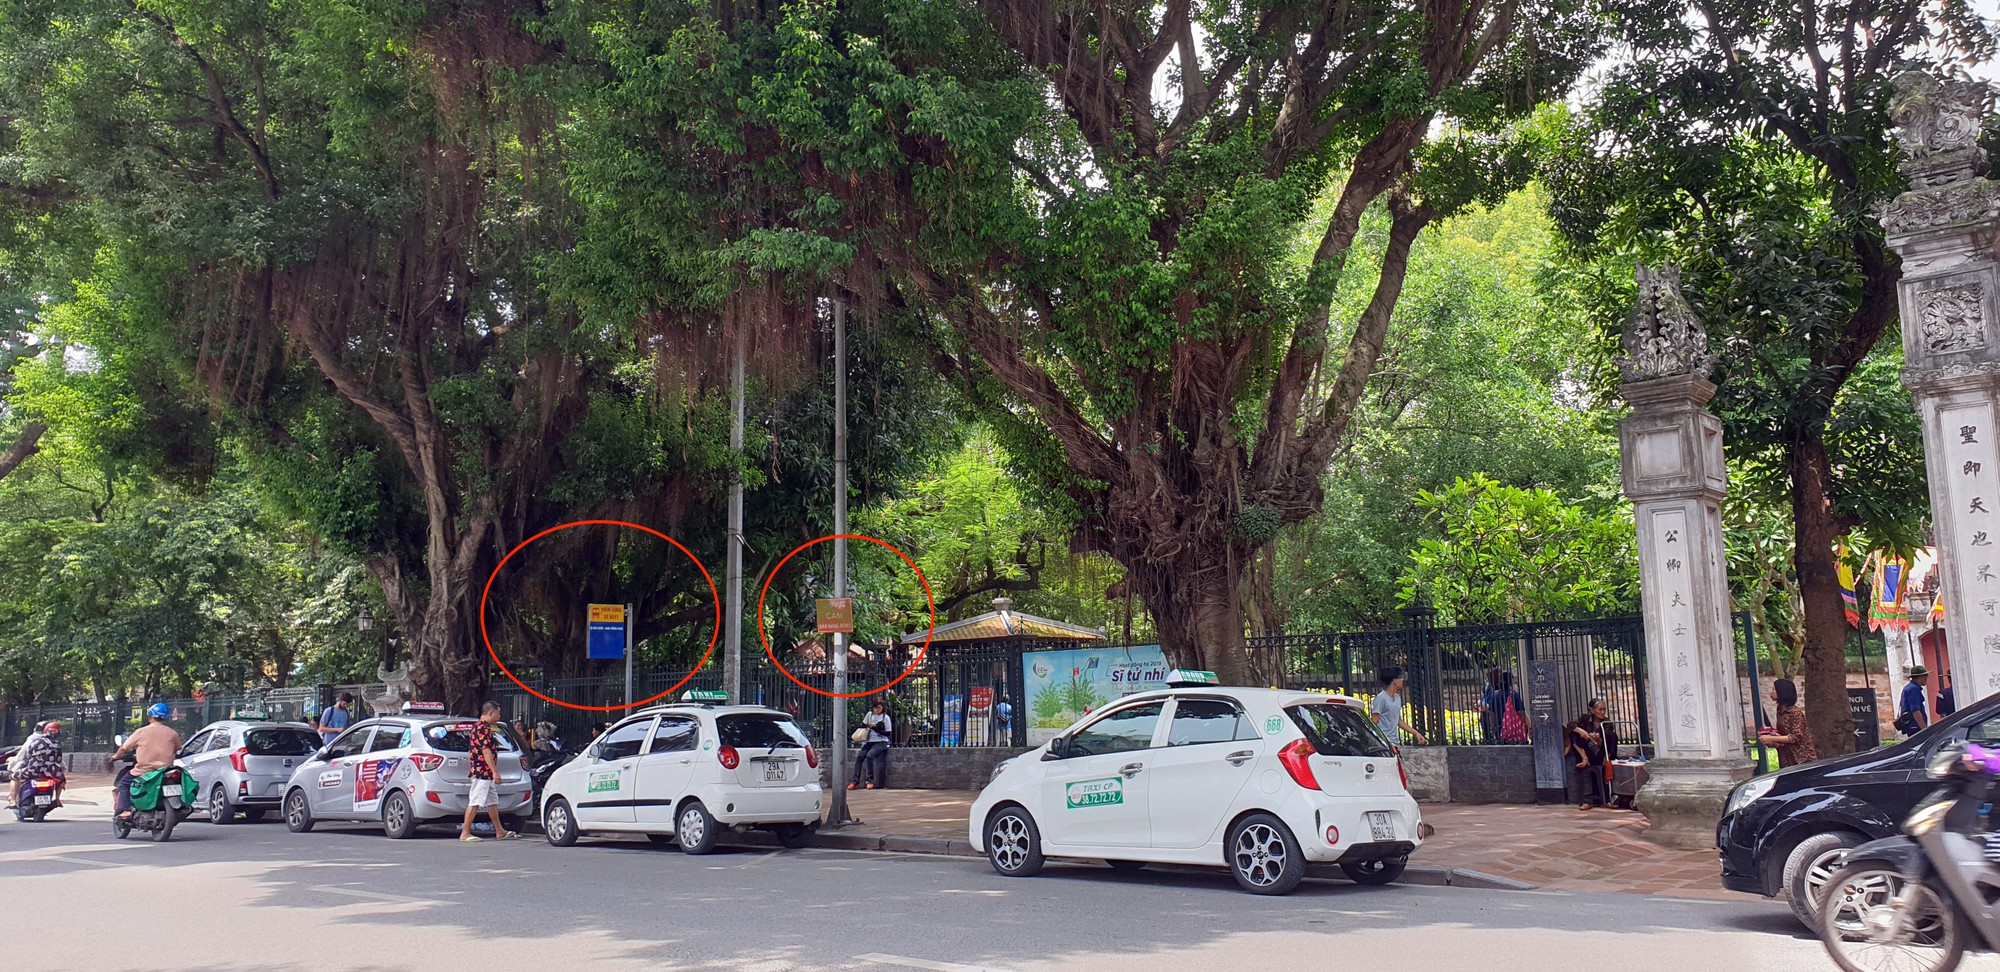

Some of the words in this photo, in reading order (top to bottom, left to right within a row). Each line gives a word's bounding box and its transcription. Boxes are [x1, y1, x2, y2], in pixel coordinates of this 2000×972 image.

[1112, 668, 1123, 682] Sĩ
[1127, 667, 1141, 682] tử
[1144, 667, 1166, 681] nhí
[692, 691, 714, 700] TAXI
[1266, 719, 1282, 731] 668
[768, 762, 780, 771] 29A
[1084, 784, 1101, 792] TAXI
[1103, 782, 1113, 790] CP
[1081, 791, 1116, 804] 38.72.72.72
[1375, 813, 1387, 826] 30A
